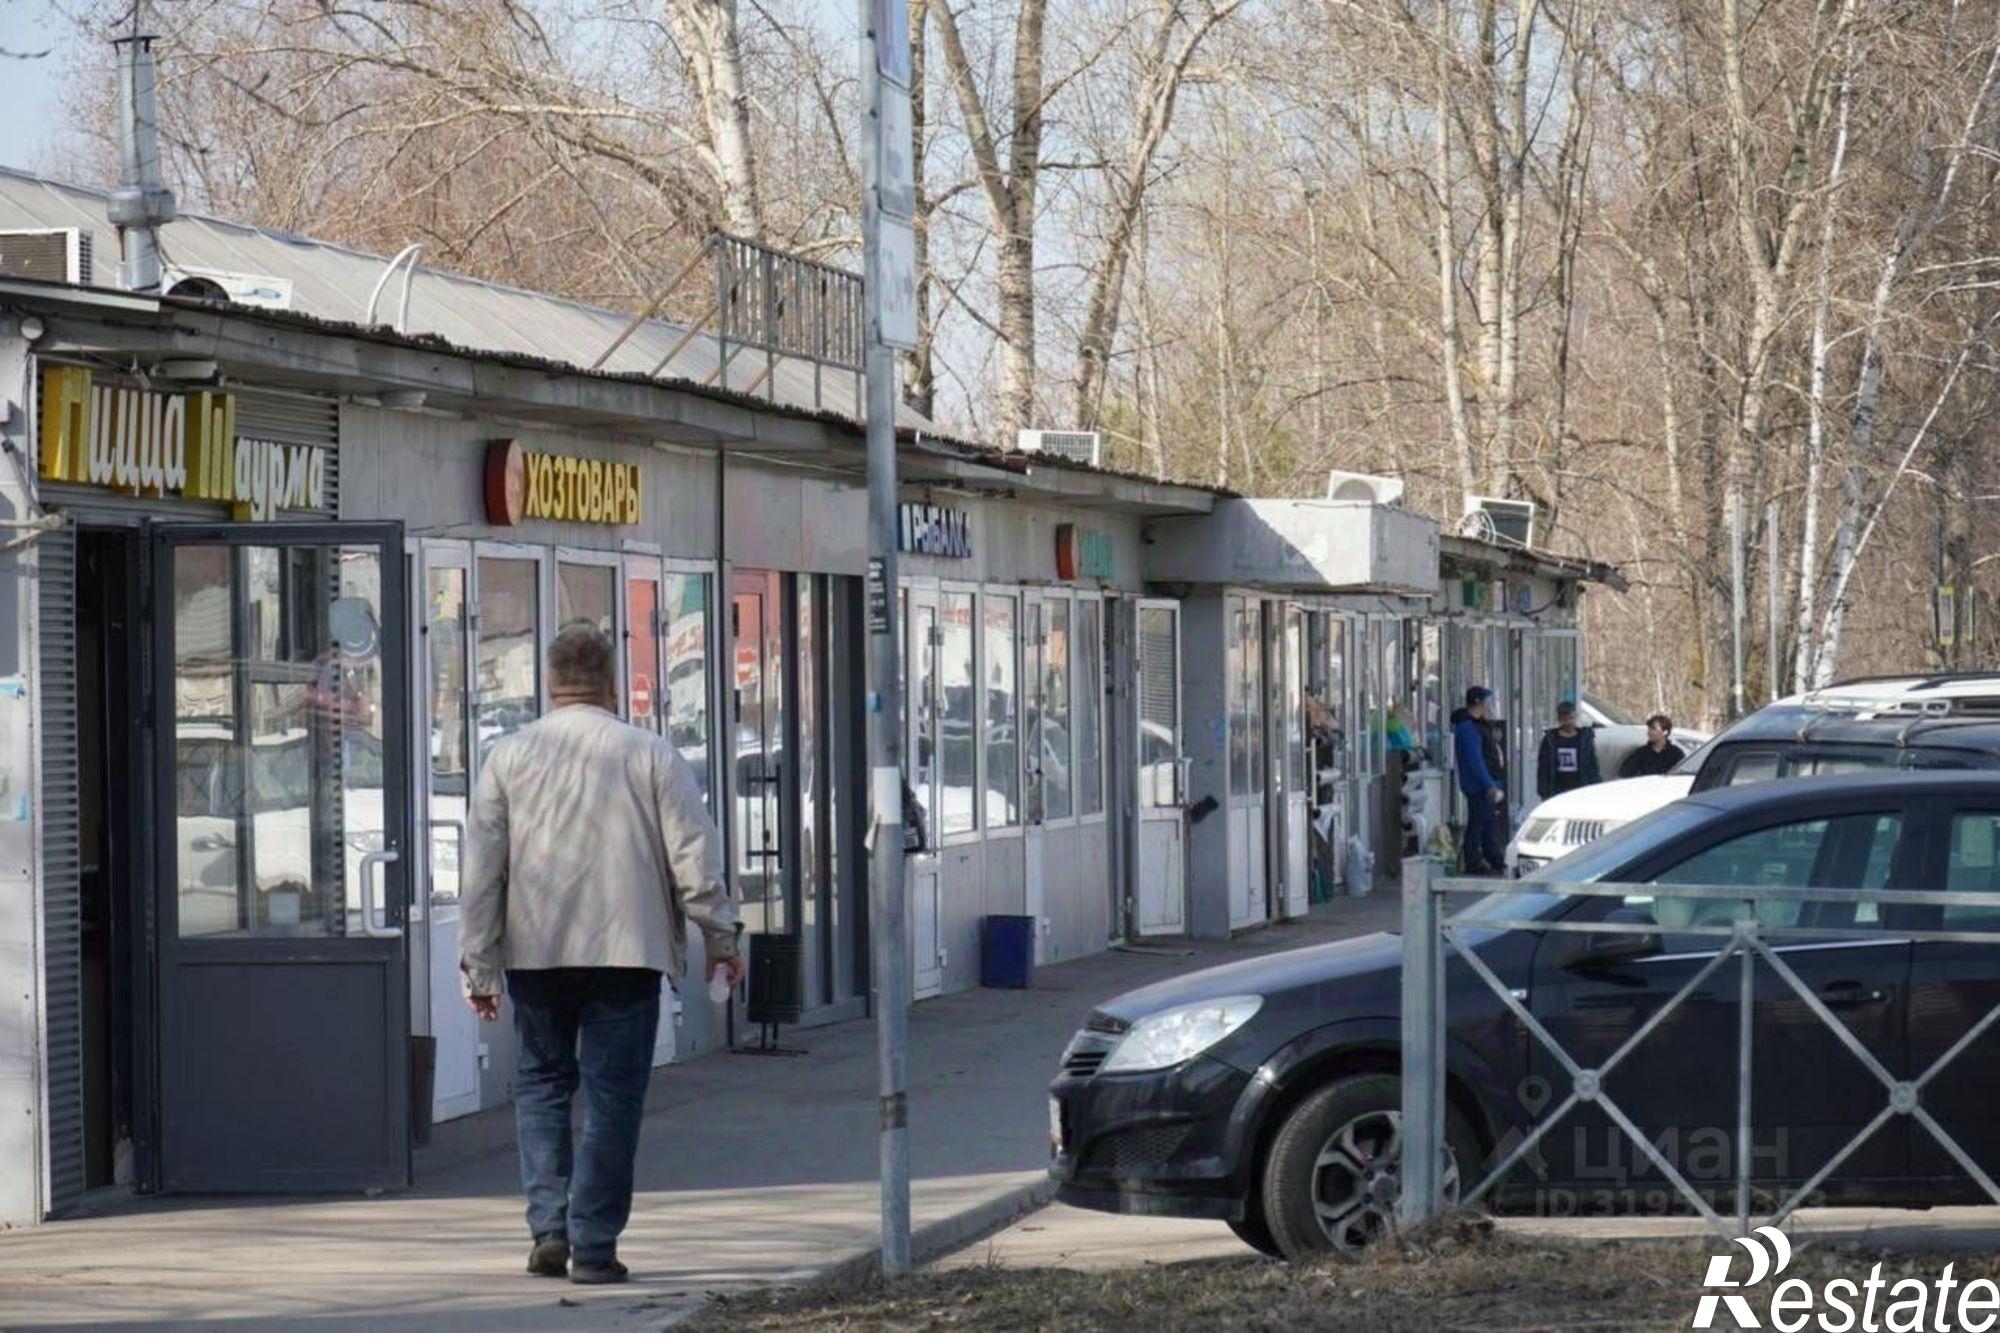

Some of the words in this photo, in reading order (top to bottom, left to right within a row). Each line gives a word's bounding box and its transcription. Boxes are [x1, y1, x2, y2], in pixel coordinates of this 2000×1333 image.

[43, 366, 187, 499] Пицца
[187, 390, 325, 522] Шаурма
[526, 452, 642, 526] ХОЗТОВАРЫ
